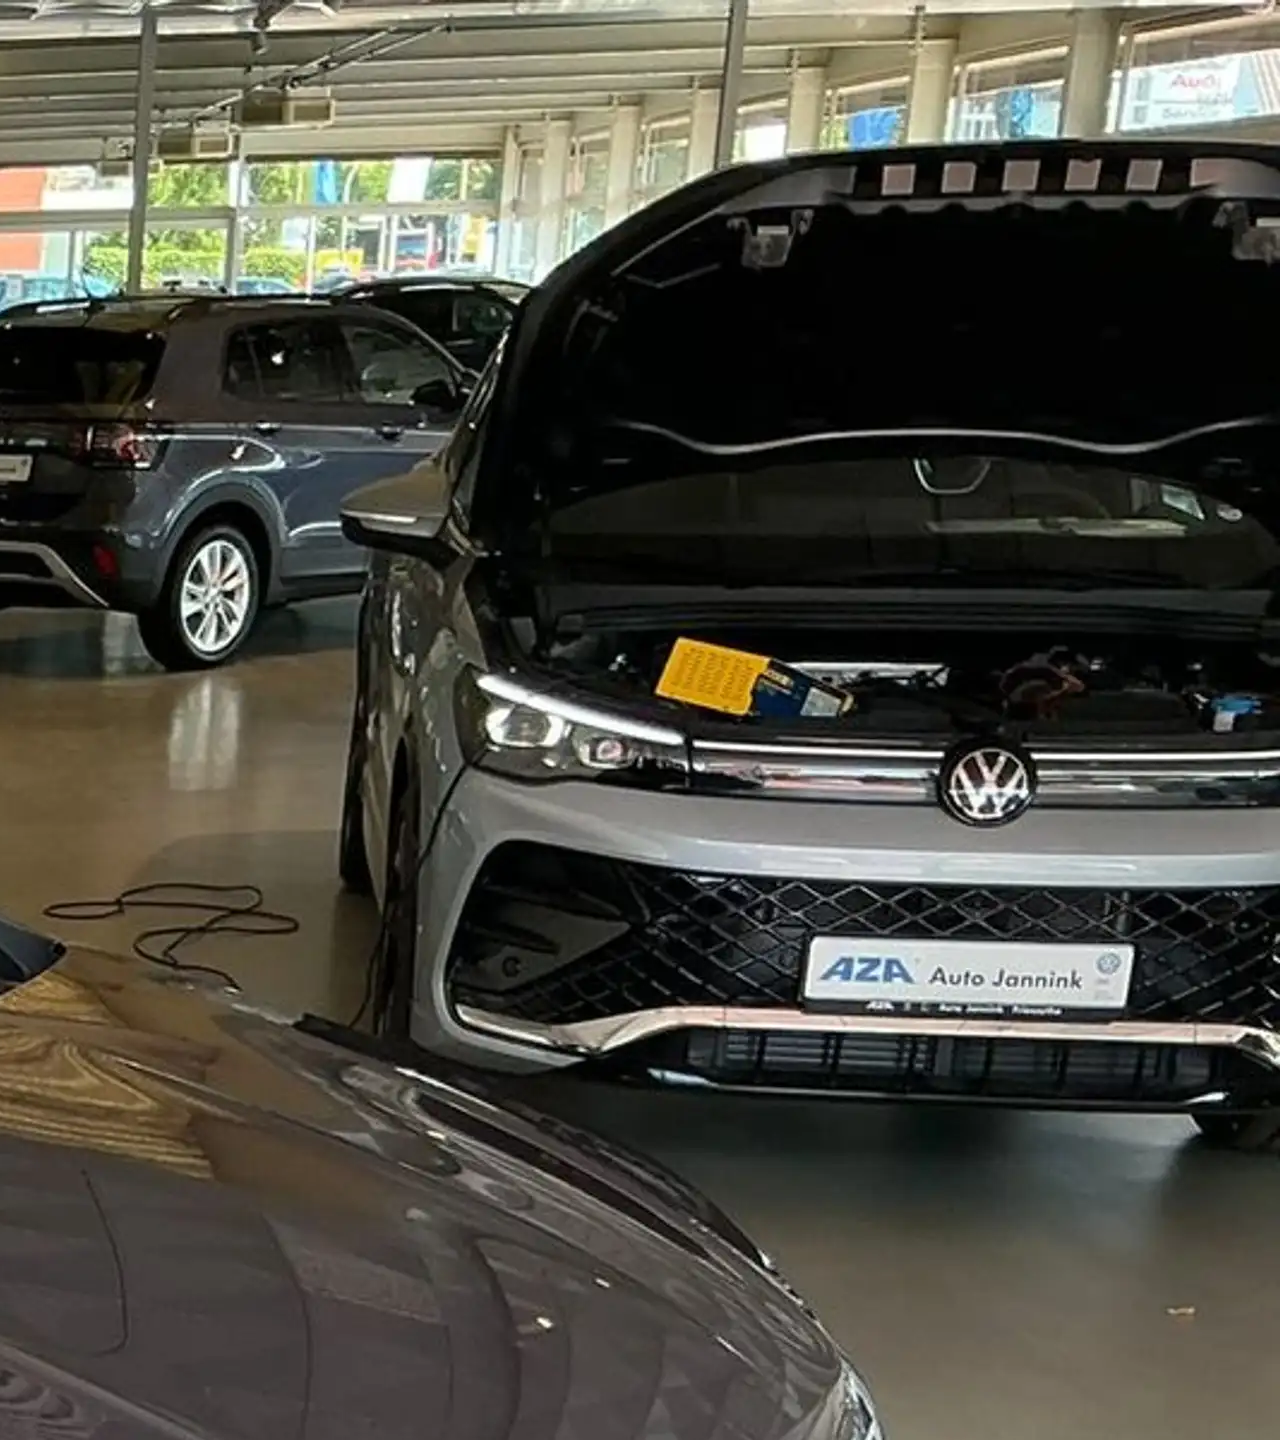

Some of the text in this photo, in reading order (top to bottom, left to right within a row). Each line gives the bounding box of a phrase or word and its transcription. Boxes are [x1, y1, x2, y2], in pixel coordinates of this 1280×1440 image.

[819, 956, 916, 985] AZA
[927, 967, 986, 988] Auto
[991, 967, 1084, 991] Jannink
